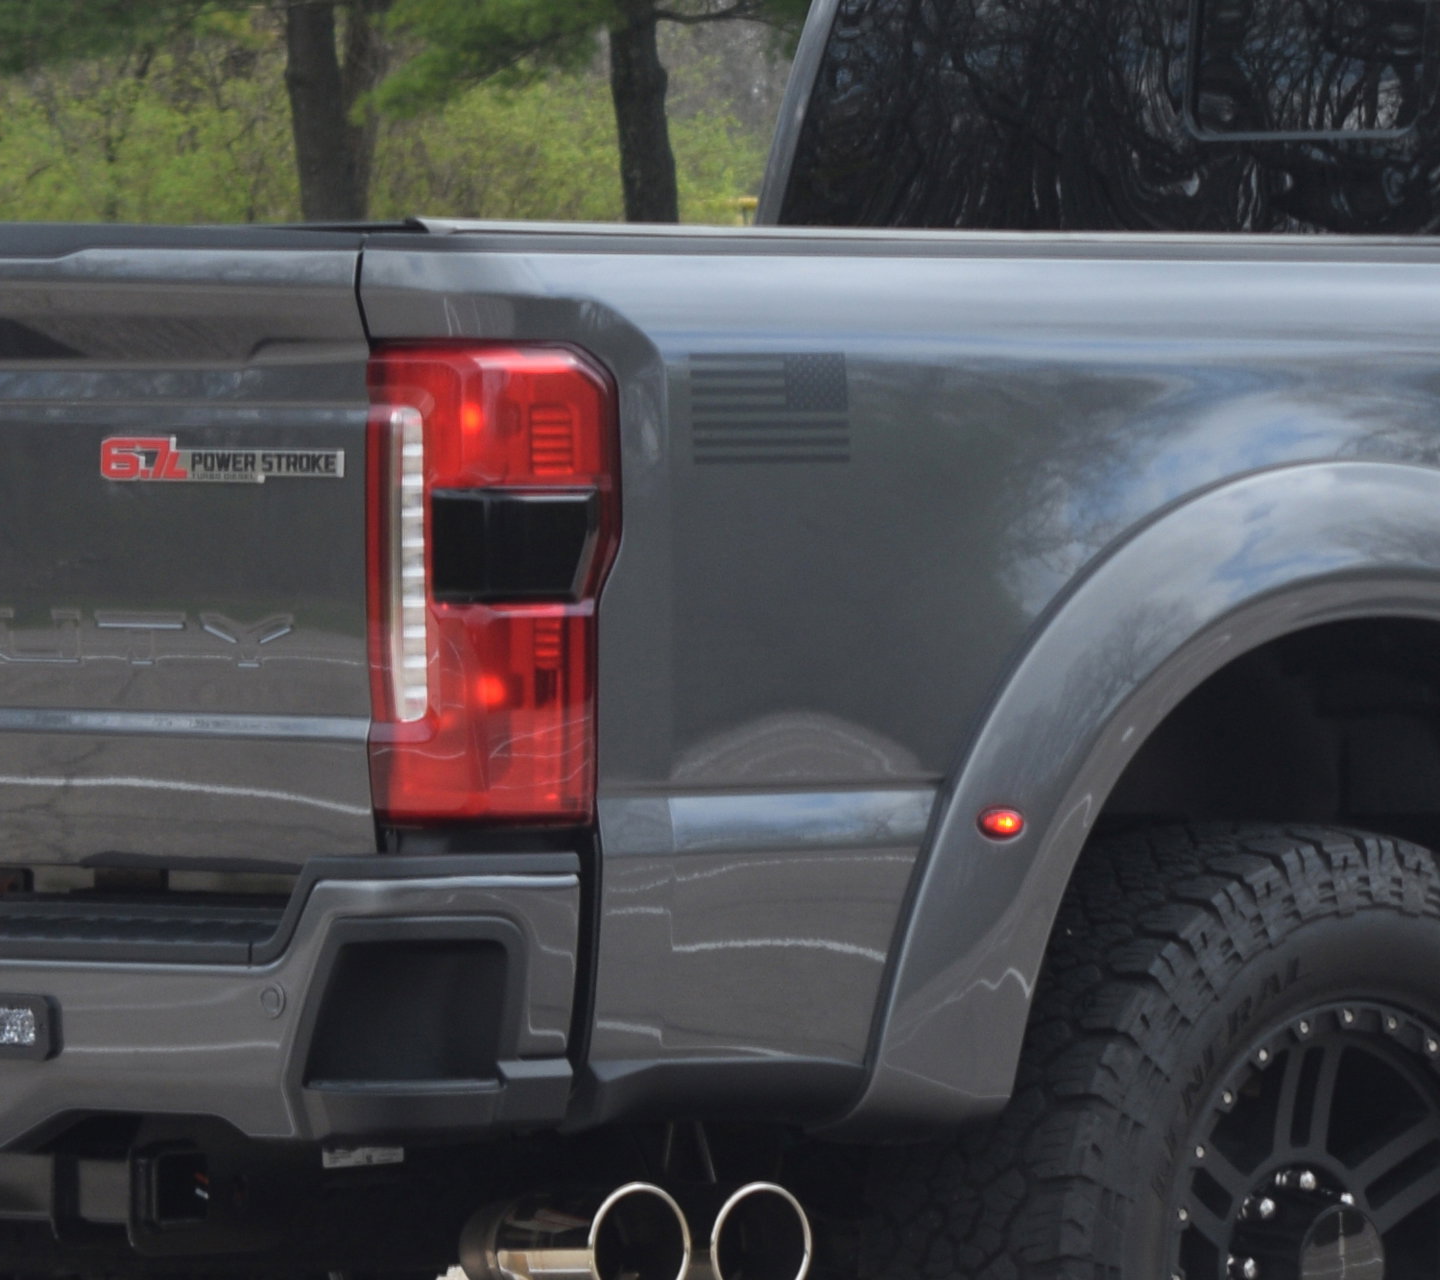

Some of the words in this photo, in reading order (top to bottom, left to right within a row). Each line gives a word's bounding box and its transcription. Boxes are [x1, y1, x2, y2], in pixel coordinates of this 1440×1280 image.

[101, 436, 188, 480] 6.7L
[191, 452, 256, 472] POWER
[261, 452, 336, 473] STROKE
